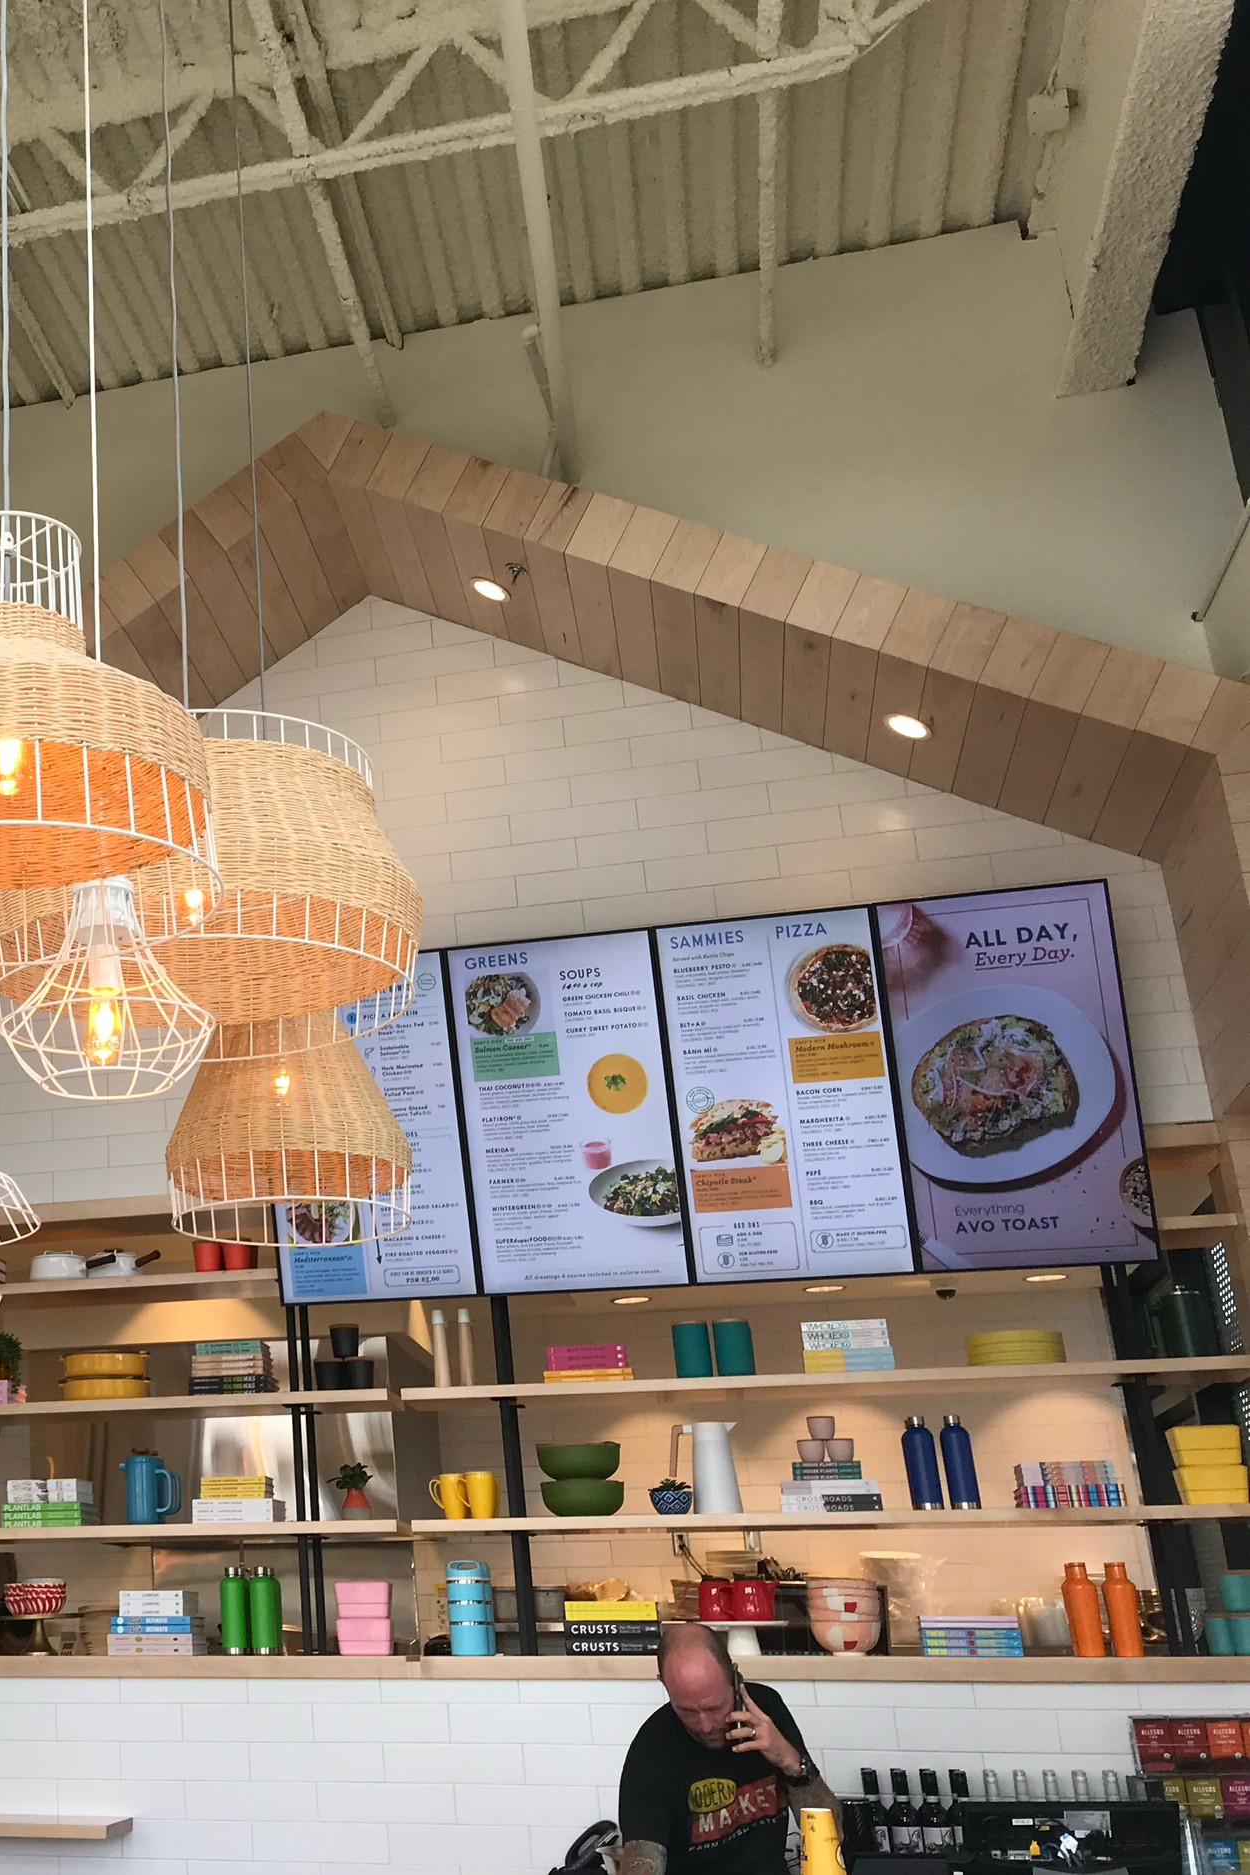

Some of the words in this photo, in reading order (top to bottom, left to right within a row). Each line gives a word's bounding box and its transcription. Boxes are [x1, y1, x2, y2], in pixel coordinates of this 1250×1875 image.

[775, 922, 827, 940] PIZZA
[965, 928, 1008, 949] ALL
[1016, 922, 1078, 944] DAY,
[670, 930, 744, 949] SAMMIES
[465, 952, 528, 970] GREENS
[974, 951, 1027, 969] Every
[1032, 946, 1076, 963] Day.
[559, 967, 601, 981] SOUPS
[674, 965, 708, 974] BLUEBERRY
[795, 1045, 825, 1053] Modern
[827, 1042, 868, 1050] Mushroom
[495, 1083, 524, 1091] COCONUT
[796, 1088, 820, 1096] BACON
[800, 1116, 844, 1124] MARGHERITA
[696, 1178, 728, 1187] Chipotle
[954, 1202, 1025, 1218] Everything
[955, 1219, 996, 1235] AVO
[1001, 1216, 1060, 1231] TOAST
[795, 1495, 853, 1503] CROSSROADS
[4, 1504, 41, 1512] PLANTLAB
[4, 1512, 42, 1520] PLANTLAB
[5, 1520, 42, 1528] PLANTLAB
[571, 1625, 618, 1634] CRUSTS
[572, 1642, 619, 1652] CRUSTS
